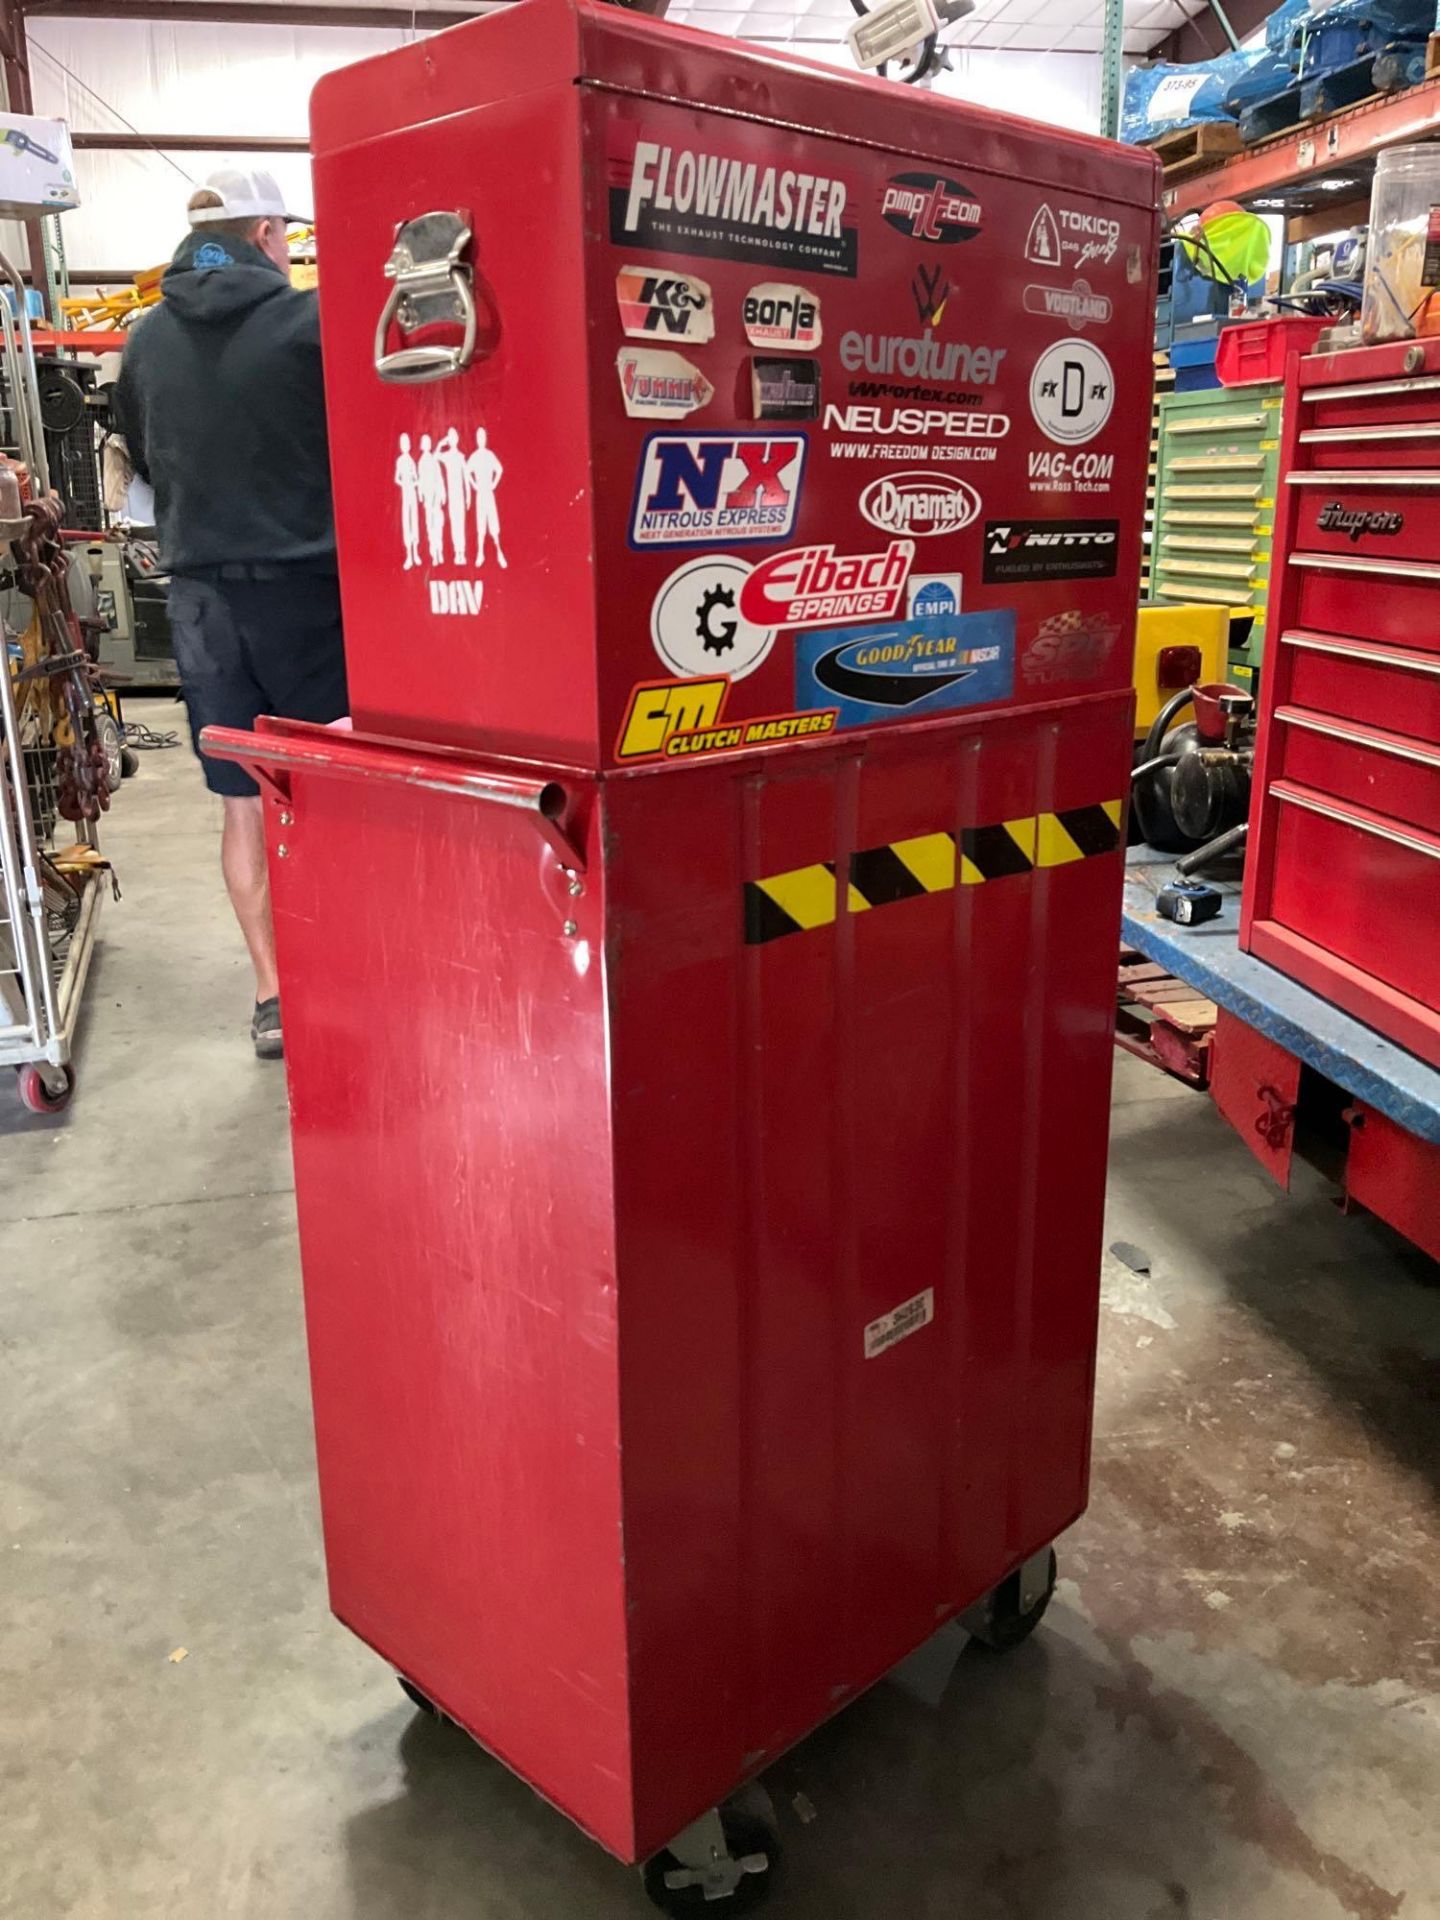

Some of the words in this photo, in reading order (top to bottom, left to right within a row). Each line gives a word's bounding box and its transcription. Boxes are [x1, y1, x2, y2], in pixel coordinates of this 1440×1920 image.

[624, 141, 846, 238] FLOWMASTER
[652, 221, 672, 233] THE
[677, 225, 724, 241] EXHAUST
[728, 233, 794, 251] TECHNOLOGY
[798, 244, 841, 258] COMPANY
[1059, 209, 1120, 239] TOKICO
[839, 328, 1007, 385] eurotuner
[1061, 361, 1085, 418] D
[822, 403, 1011, 438] NEUSPEED
[830, 443, 929, 460] WWW.FREEDOM
[931, 446, 998, 461] DESIGN.COM
[1028, 451, 1115, 479] VAG-COM
[645, 441, 797, 512] NX
[640, 510, 714, 530] NITROUS
[716, 507, 787, 527] EXPRESS
[880, 481, 964, 530] Dynamat
[1024, 531, 1116, 546] NITTO
[740, 544, 907, 625] Eibach
[786, 592, 888, 622] SPRINGS
[915, 601, 954, 616] EMPI
[666, 729, 739, 755] CLUTCH
[745, 713, 835, 741] MASTERS
